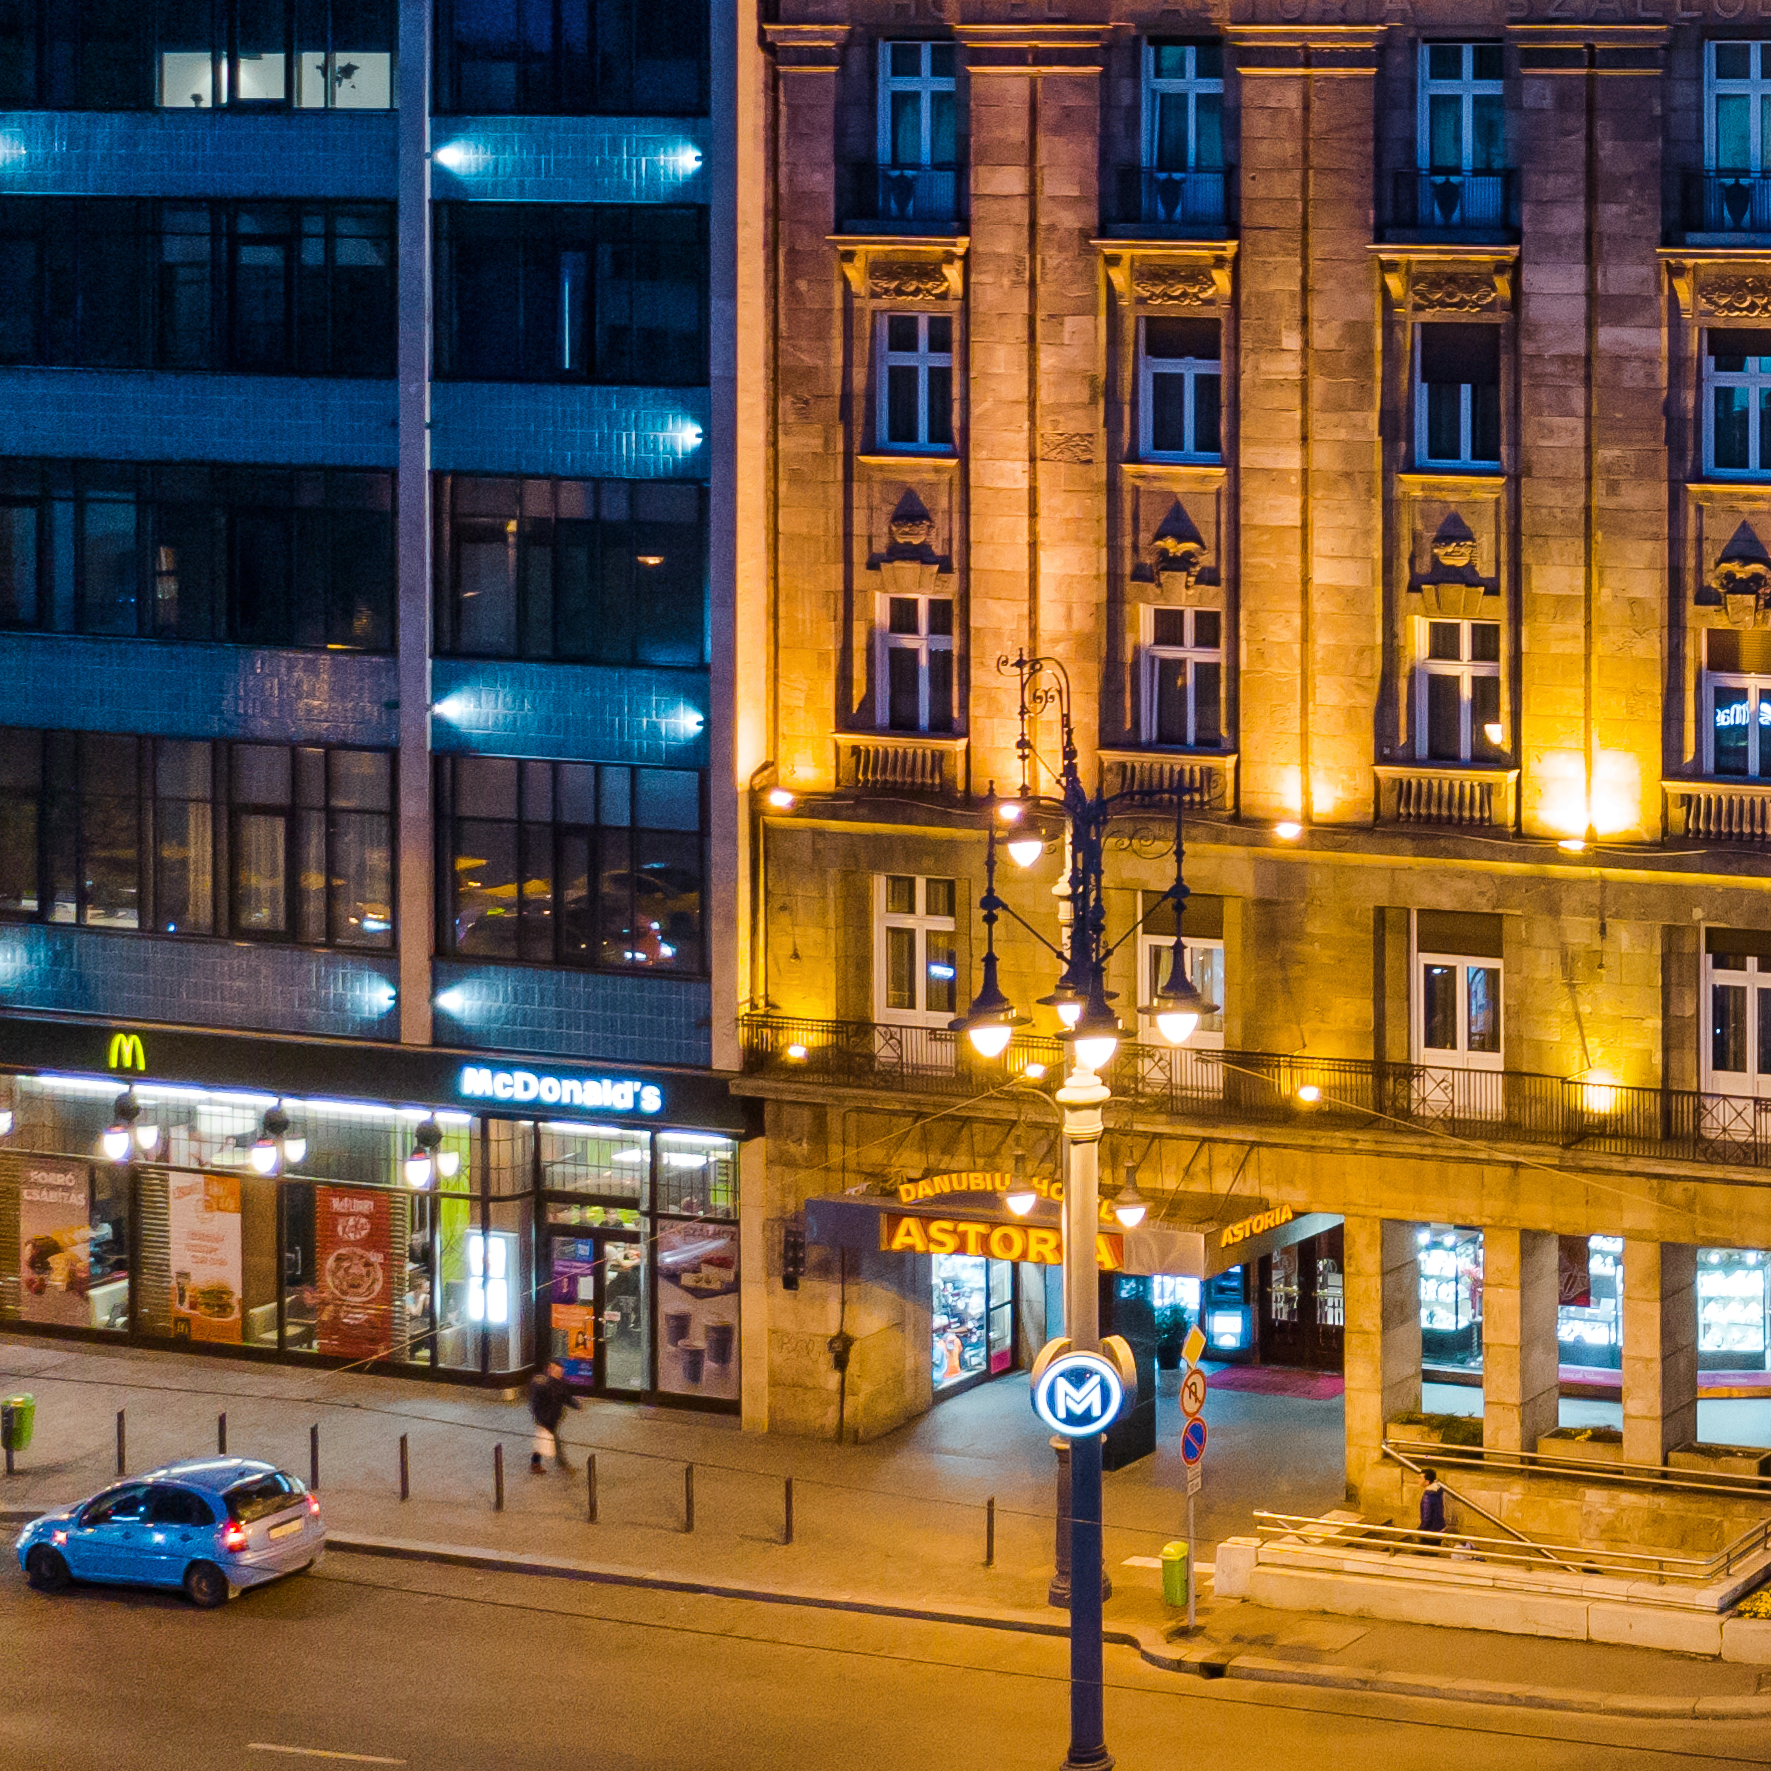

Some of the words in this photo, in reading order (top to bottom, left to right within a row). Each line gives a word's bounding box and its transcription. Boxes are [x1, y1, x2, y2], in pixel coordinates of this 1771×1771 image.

[463, 1065, 662, 1114] McDonald's
[899, 1171, 1012, 1204] DANUBIU
[1031, 1177, 1116, 1222] HOL
[891, 1216, 1125, 1270] ASTORA
[1220, 1205, 1293, 1248] ASTORIA
